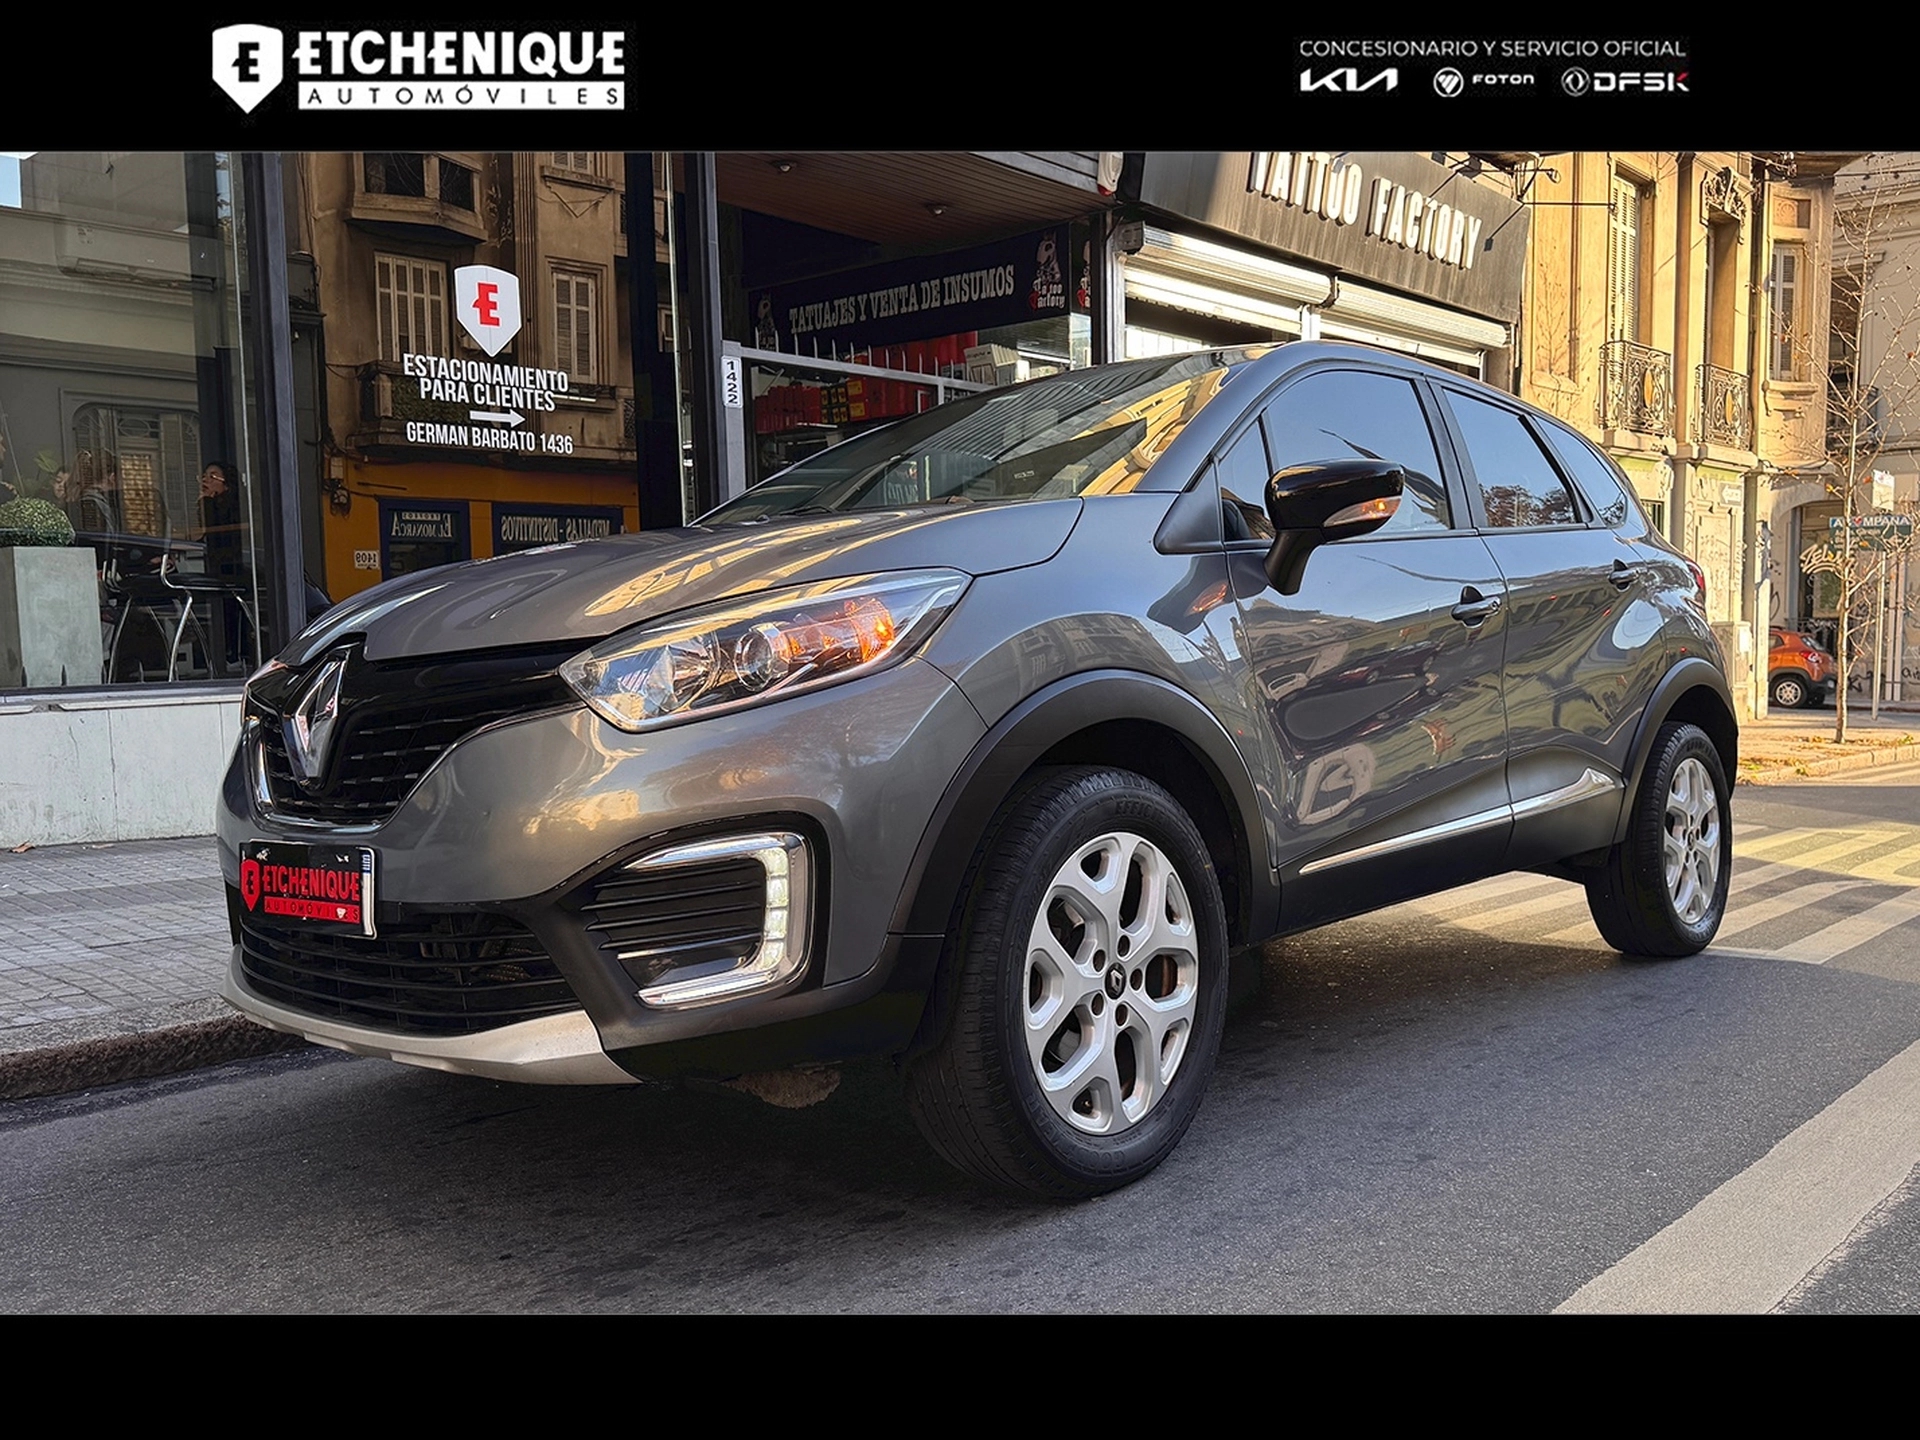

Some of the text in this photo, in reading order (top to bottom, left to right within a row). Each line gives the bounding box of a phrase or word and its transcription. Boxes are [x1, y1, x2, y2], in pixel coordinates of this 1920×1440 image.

[1369, 177, 1482, 270] FACTORY
[788, 264, 1015, 334] TATUAJES Y VENTA DE INSUMOS
[403, 353, 569, 392] ESTACIONAMIENTO
[726, 360, 738, 404] 1422
[420, 377, 556, 412] PARA CLIENTES
[406, 421, 573, 454] GERMAN BARBATO 1436
